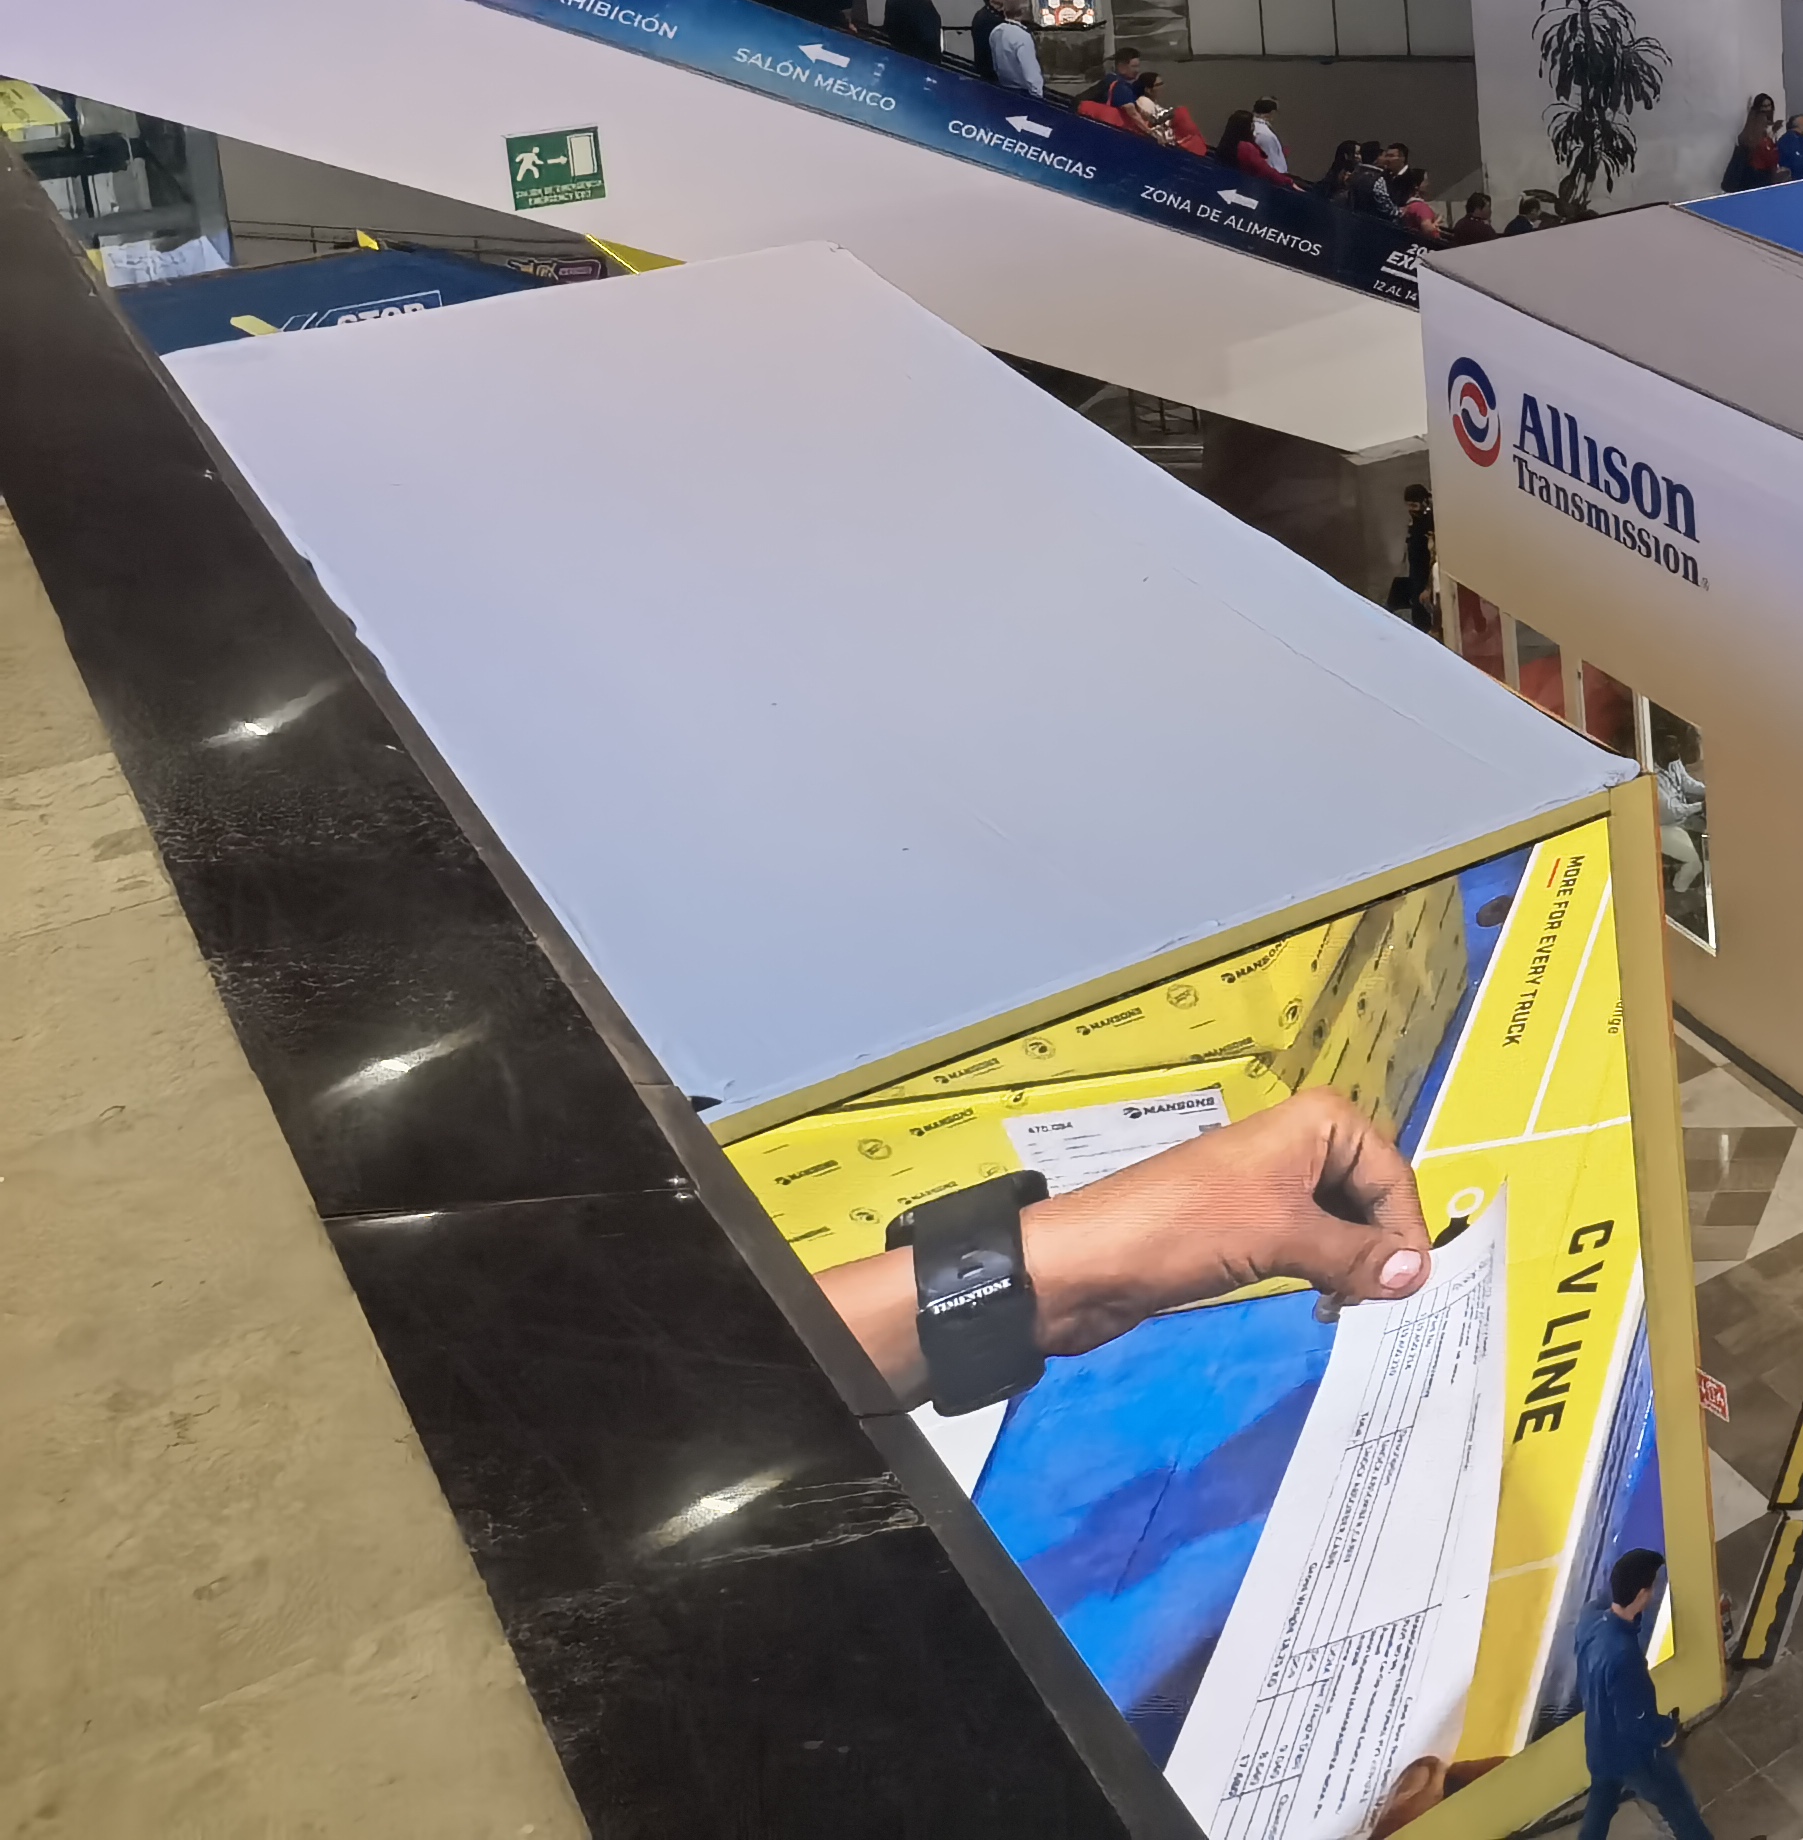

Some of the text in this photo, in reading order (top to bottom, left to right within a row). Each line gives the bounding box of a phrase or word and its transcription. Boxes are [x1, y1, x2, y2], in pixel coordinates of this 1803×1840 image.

[731, 47, 898, 113] SALÓN MÉXICO
[947, 119, 1098, 181] CONFERENCIAS
[1140, 184, 1323, 259] ZONA DE ALIMENTOS
[1511, 452, 1703, 588] Transmission
[1513, 392, 1701, 544] Allison
[1502, 854, 1586, 1048] MORE FOR EVERY TRUCK
[1512, 1219, 1615, 1445] CV LINE
